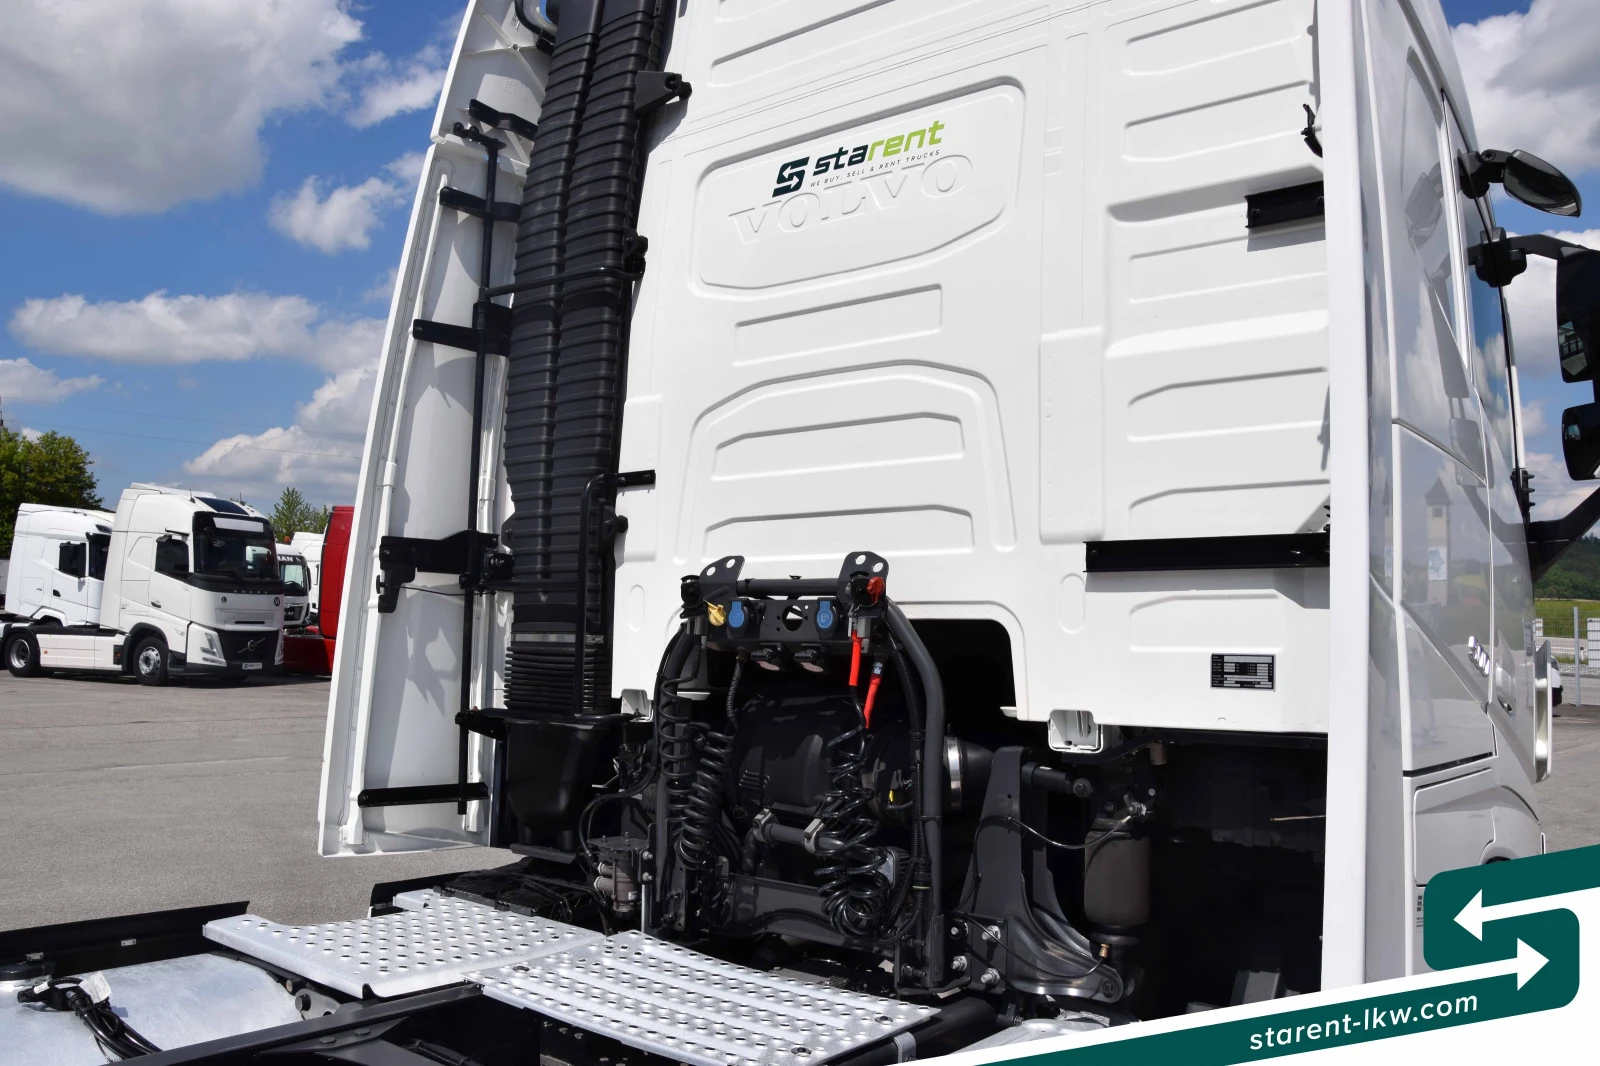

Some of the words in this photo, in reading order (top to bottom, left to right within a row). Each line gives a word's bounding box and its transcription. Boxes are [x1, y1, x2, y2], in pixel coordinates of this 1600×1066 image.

[810, 180, 820, 188] WE
[847, 169, 865, 178] SELL
[878, 159, 901, 170] RENT
[905, 150, 940, 163] TRUCKS
[812, 120, 945, 177] starent
[728, 154, 973, 245] VOLVO
